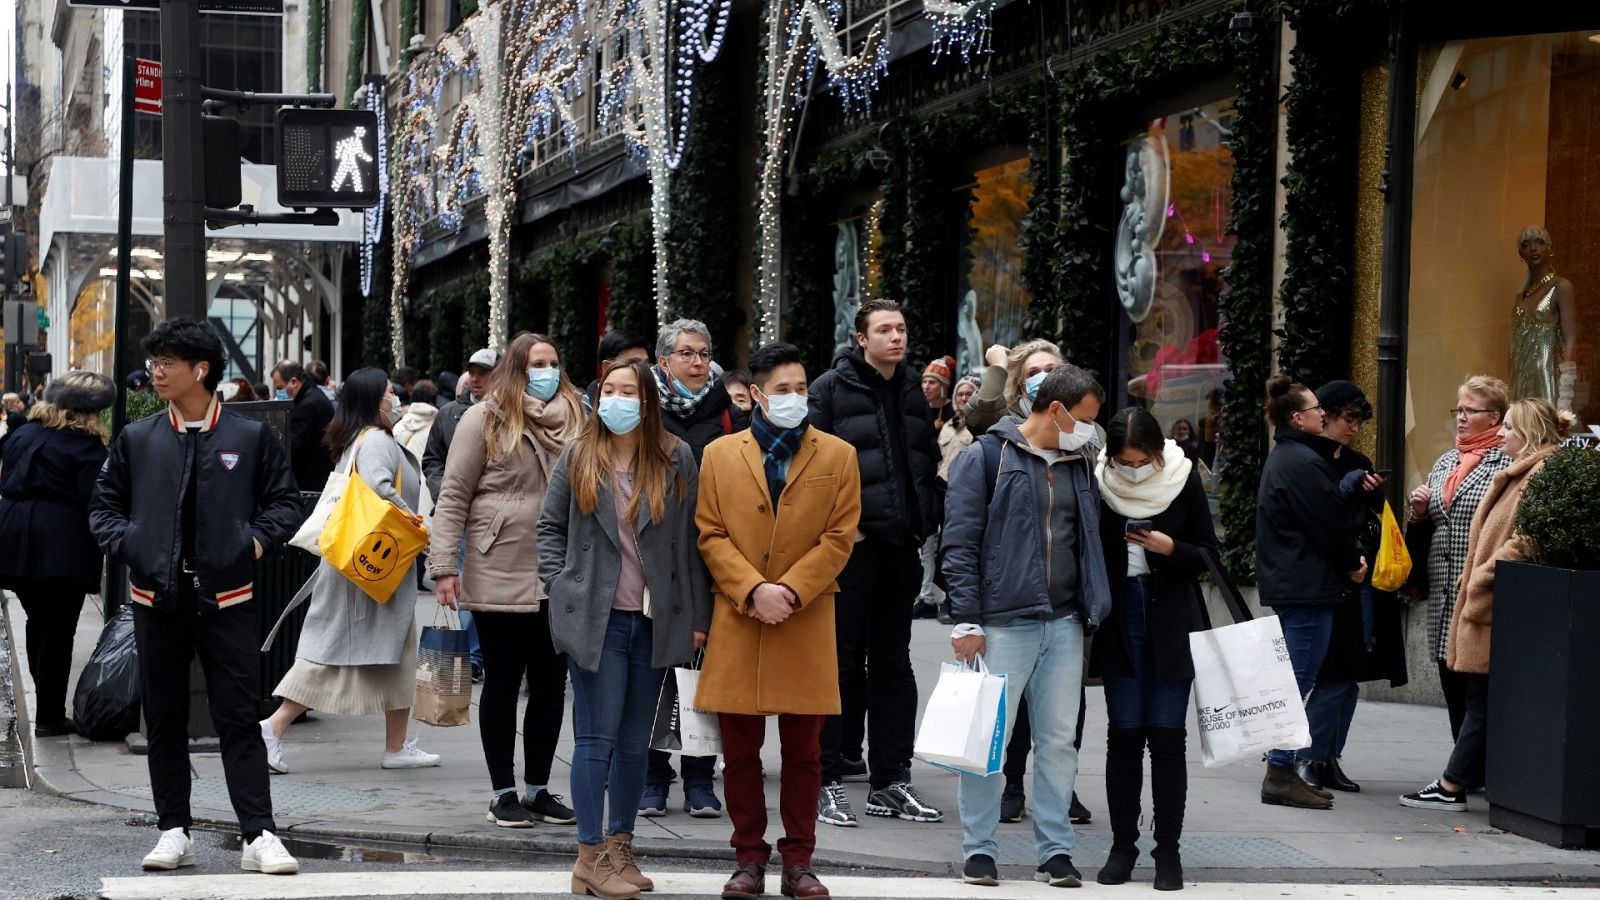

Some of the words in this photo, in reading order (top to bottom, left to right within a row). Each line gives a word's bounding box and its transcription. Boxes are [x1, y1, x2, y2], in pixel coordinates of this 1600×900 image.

[137, 64, 161, 78] STANDI
[135, 77, 154, 88] ytime
[1557, 435, 1590, 449] ority
[359, 553, 383, 574] drew
[1200, 713, 1224, 724] OUSE
[1225, 711, 1237, 720] OF
[1238, 700, 1286, 718] INNOVATION
